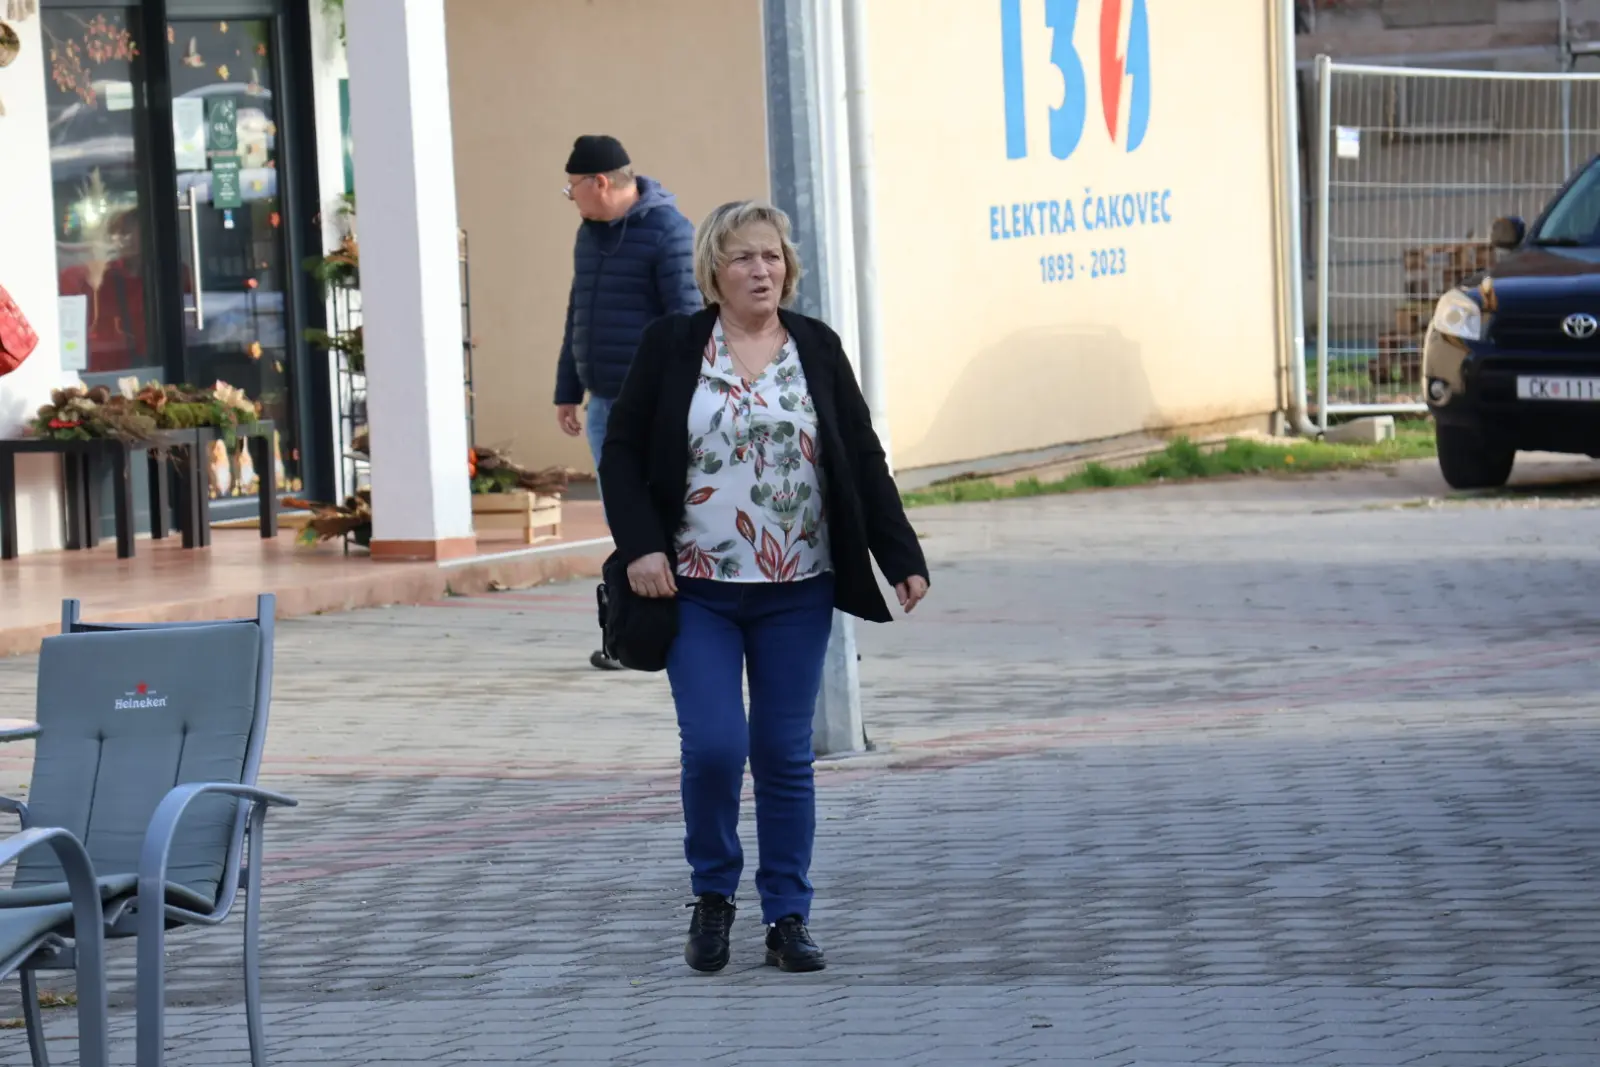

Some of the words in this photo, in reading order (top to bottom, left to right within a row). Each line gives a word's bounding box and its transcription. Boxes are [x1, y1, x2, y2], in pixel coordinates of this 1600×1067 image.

[989, 199, 1077, 241] ELEKTRA
[1082, 187, 1172, 231] ČAKOVEC
[1040, 252, 1074, 282] 1893
[1090, 247, 1126, 279] 2023
[115, 698, 167, 710] Heineken
